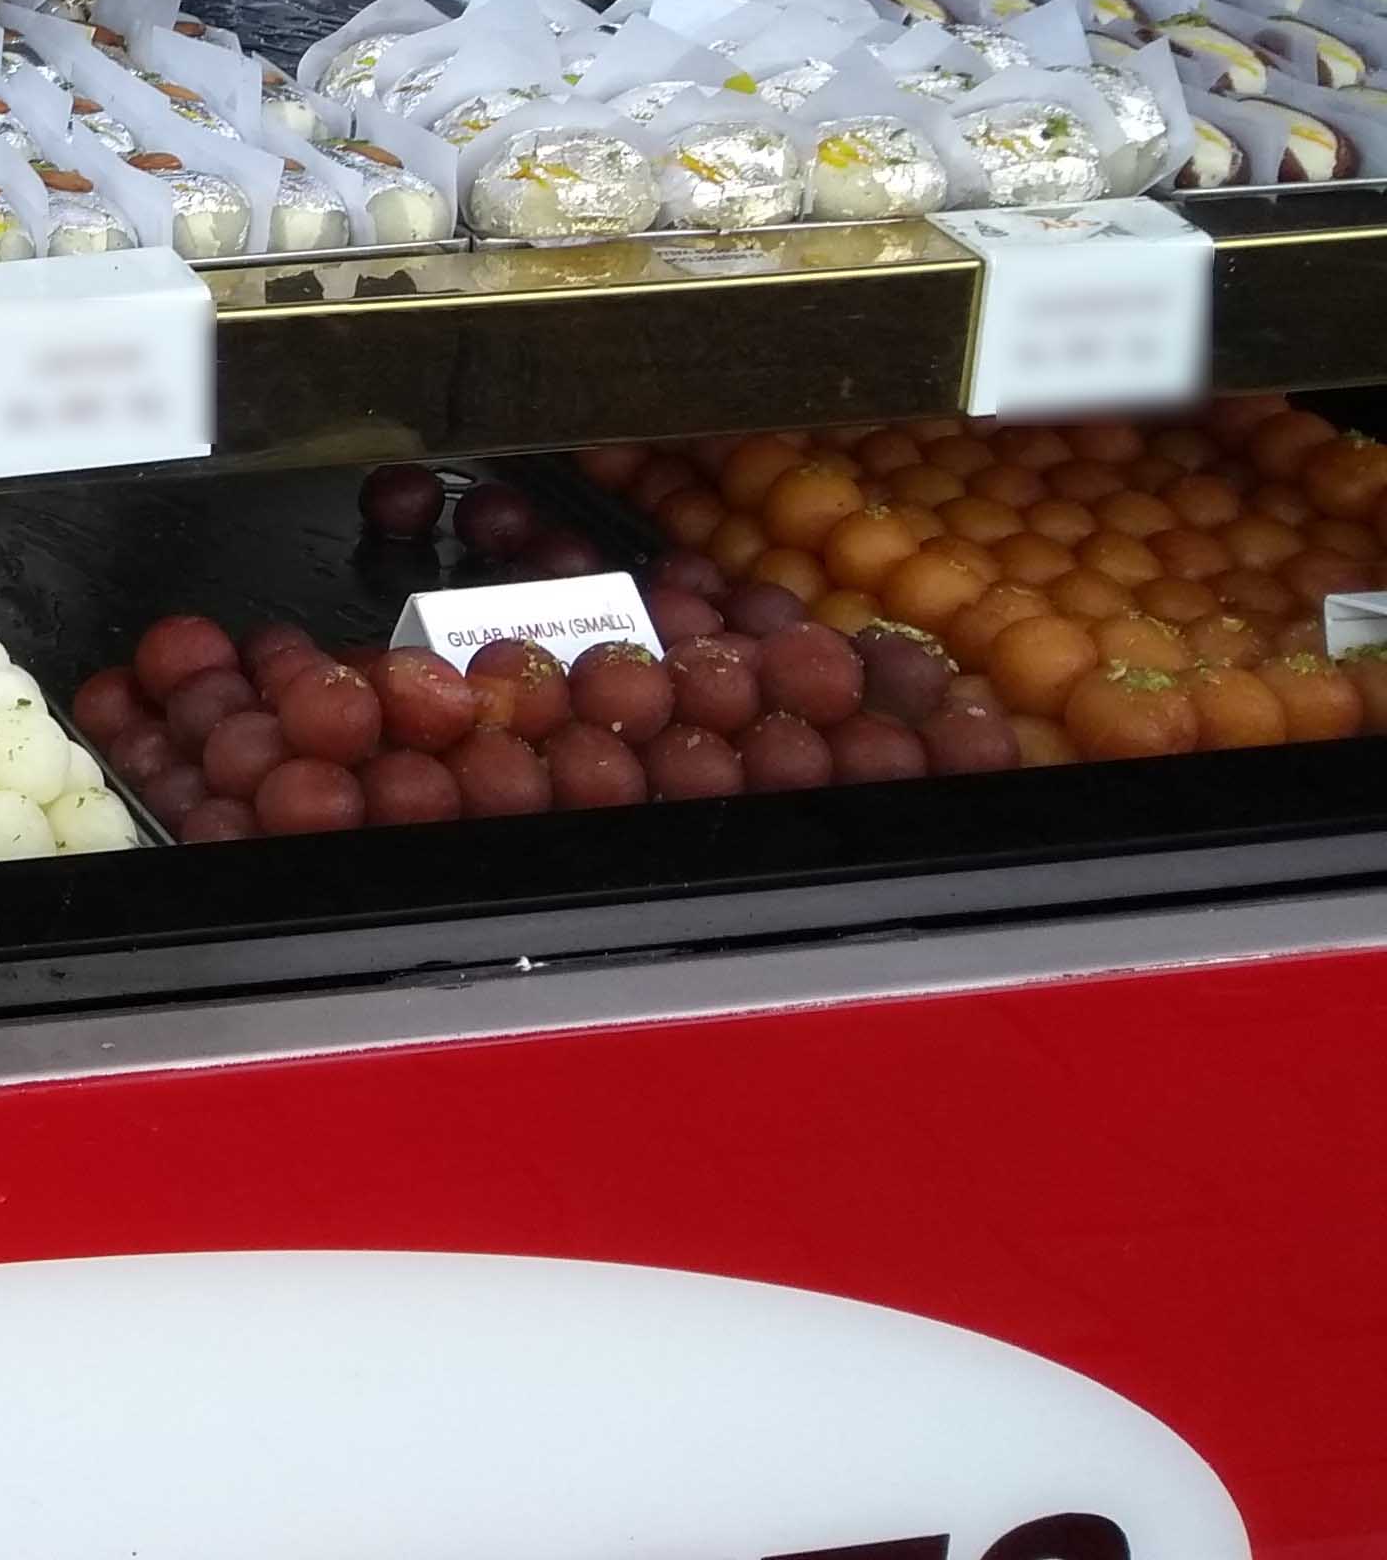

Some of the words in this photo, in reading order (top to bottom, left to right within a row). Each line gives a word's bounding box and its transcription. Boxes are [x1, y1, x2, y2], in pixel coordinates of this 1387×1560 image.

[447, 625, 504, 647] GULAB
[508, 620, 566, 641] JAMUN
[568, 613, 636, 637] (SMALL)
